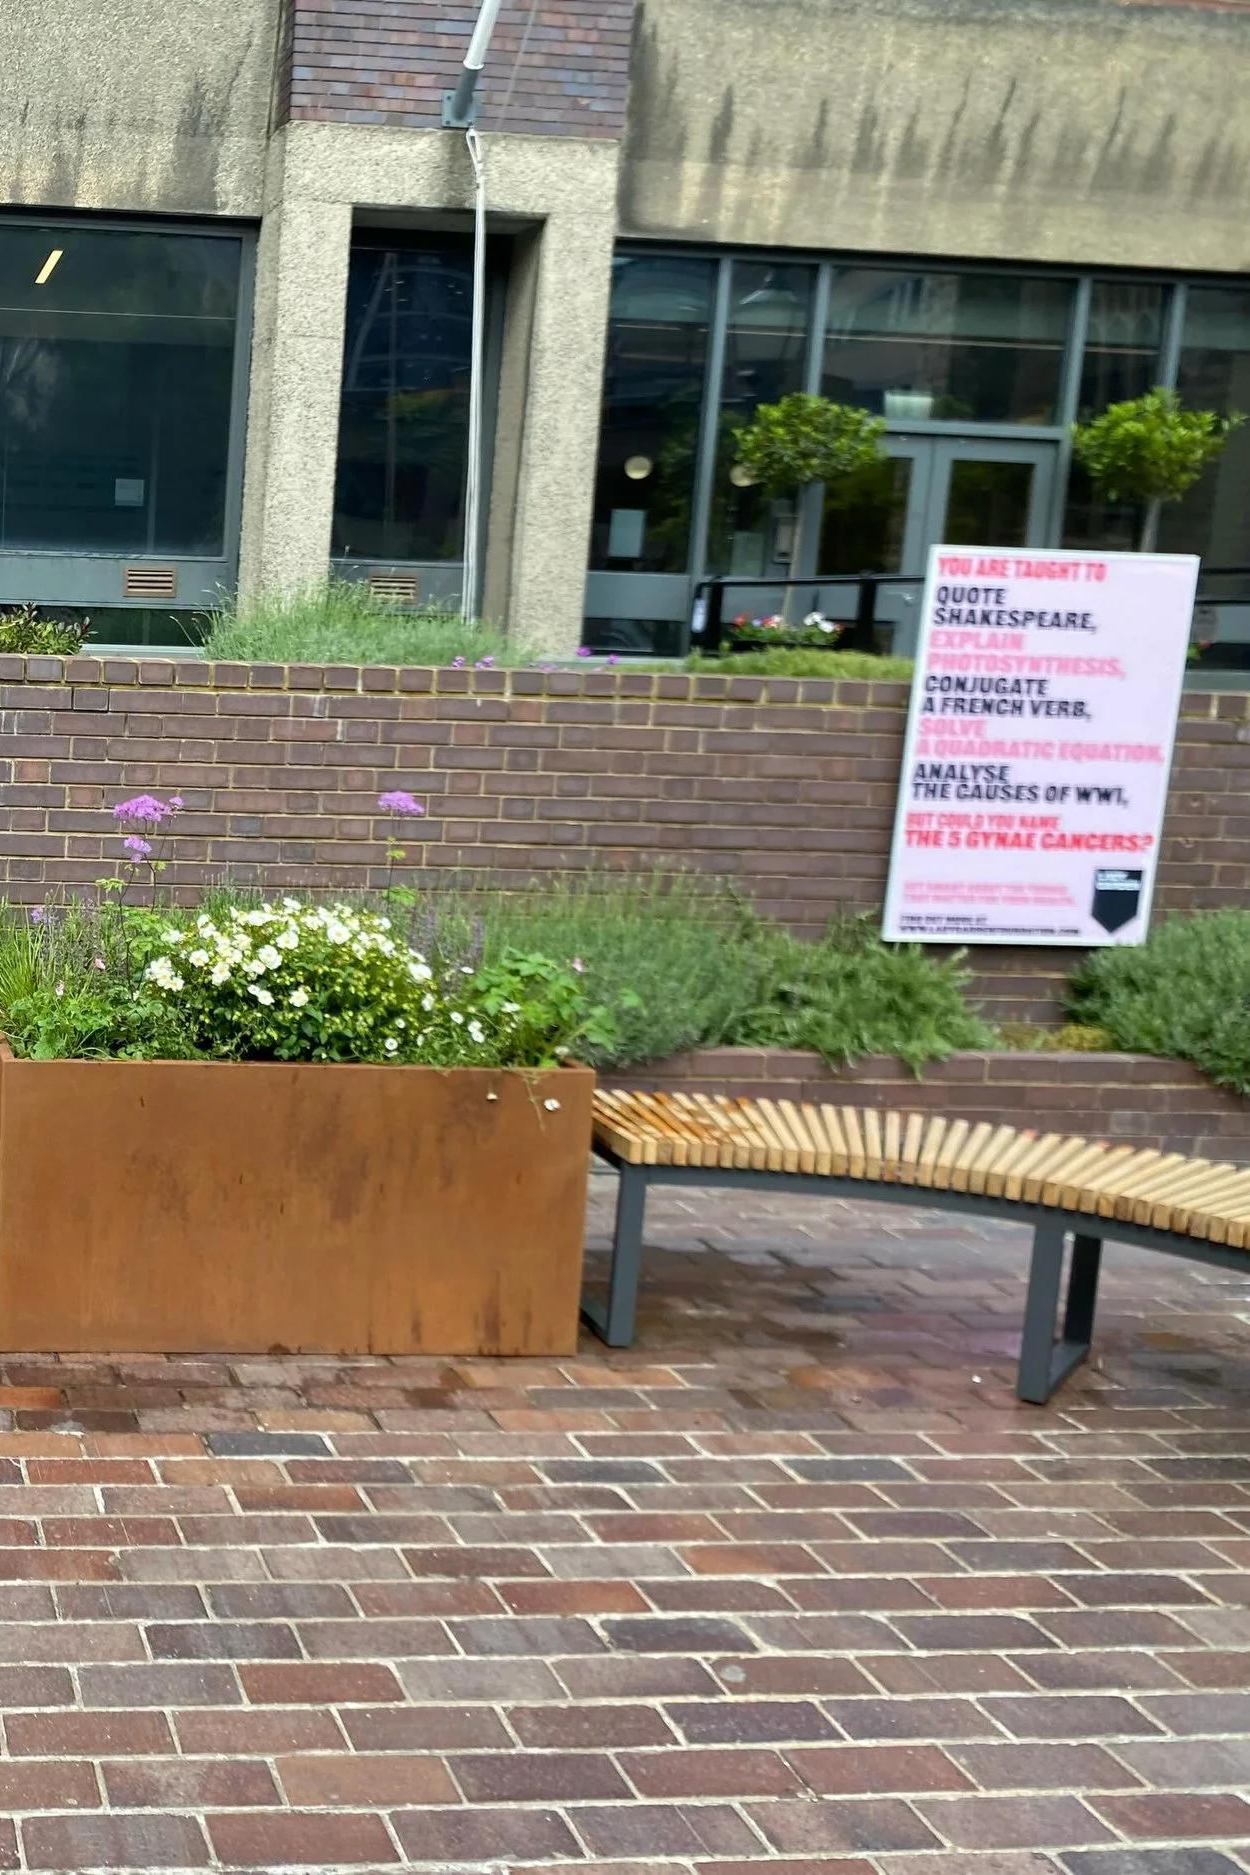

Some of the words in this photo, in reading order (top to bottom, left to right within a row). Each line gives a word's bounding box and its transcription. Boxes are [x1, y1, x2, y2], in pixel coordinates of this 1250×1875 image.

[937, 556, 972, 577] YOU
[976, 558, 1008, 578] ARE
[1014, 559, 1081, 580] TAUGHT
[1085, 562, 1107, 581] TO
[936, 585, 1006, 605] QUOTE
[934, 607, 1097, 633] SHAKESPEARE,
[930, 630, 1024, 649] EXPLAIN
[925, 675, 1048, 695] CONJUGATE
[922, 697, 935, 713] A
[940, 698, 1024, 715] FRENCH
[1030, 700, 1092, 721] VERB,
[918, 718, 986, 736] SOLVE
[916, 738, 930, 756] A
[933, 739, 1054, 759] QUADRATIC
[914, 763, 1011, 781] ANALYSE
[912, 782, 952, 799] THE
[956, 783, 1039, 801] CAUSES
[1045, 785, 1071, 803] OF
[937, 813, 984, 829] COULD
[988, 814, 1015, 829] YOU
[905, 829, 944, 847] THE
[948, 830, 962, 848] 5
[966, 831, 1036, 849] GYNAE
[1041, 833, 1154, 851] CANCERS?
